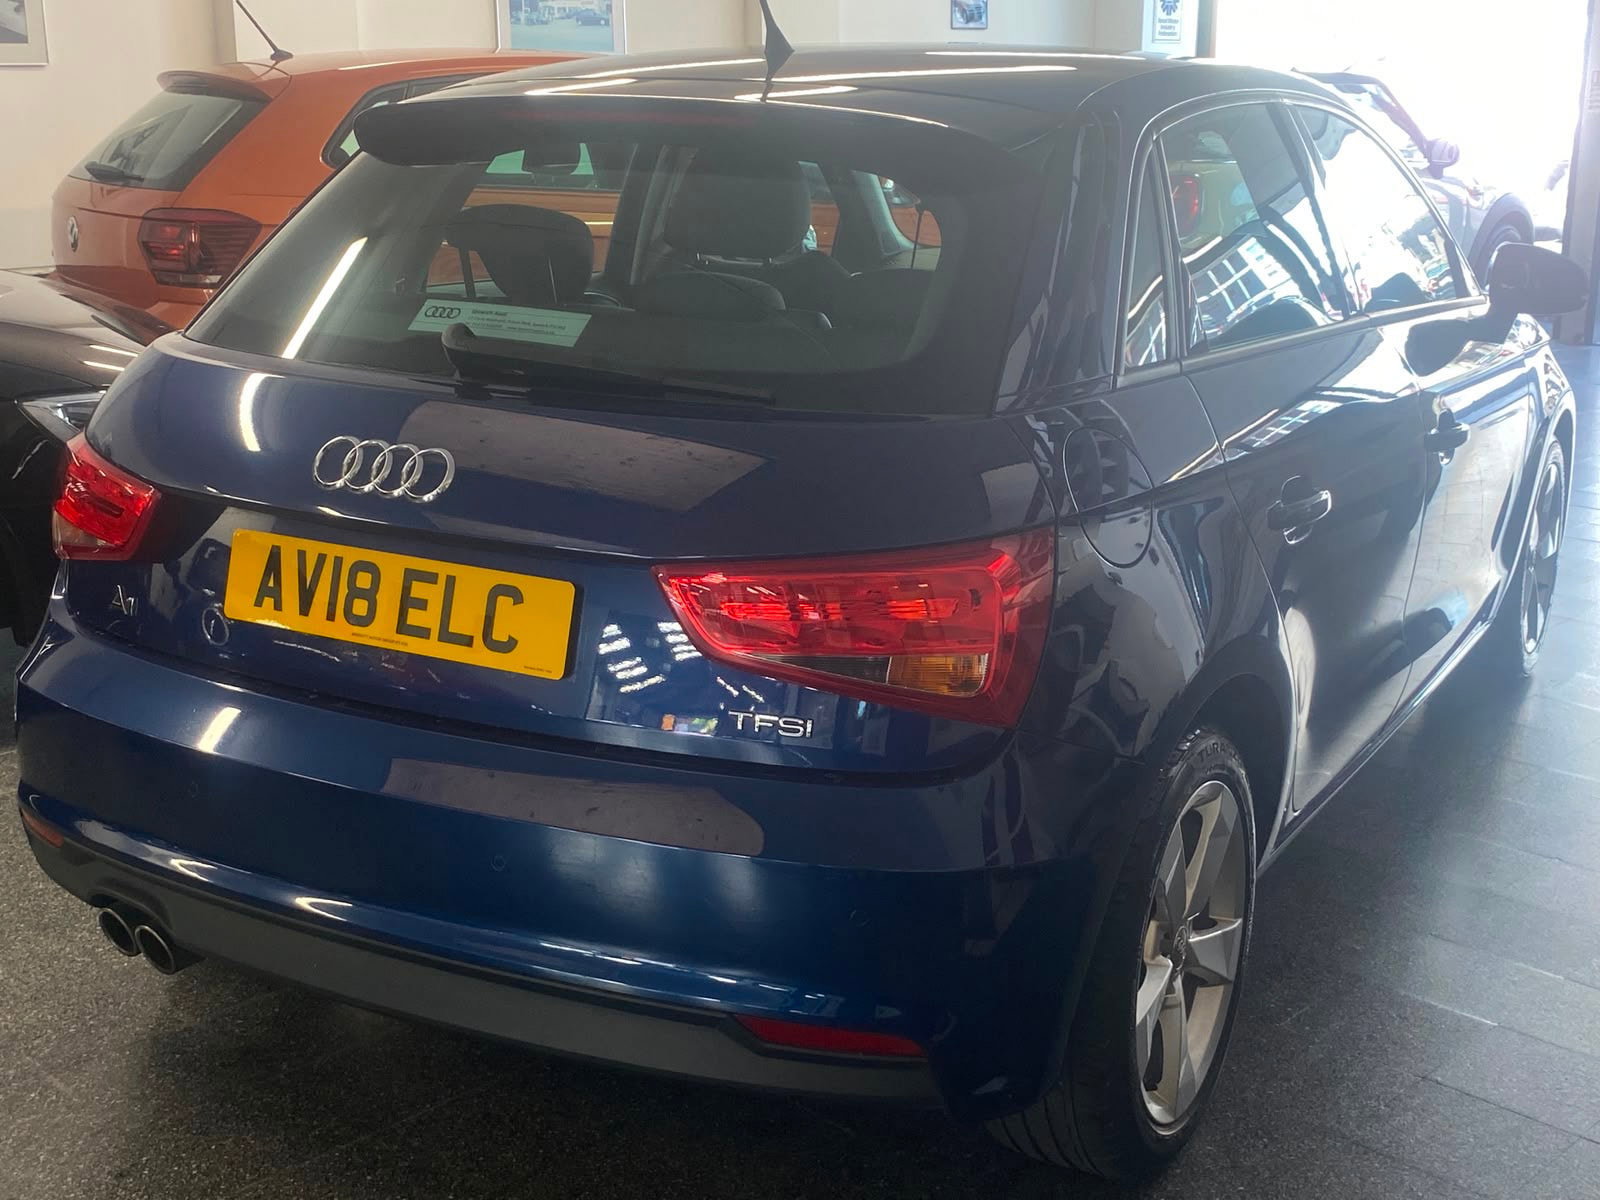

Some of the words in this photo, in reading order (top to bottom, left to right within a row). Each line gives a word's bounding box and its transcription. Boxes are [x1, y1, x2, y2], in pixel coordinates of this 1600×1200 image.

[111, 585, 137, 617] A1
[254, 545, 380, 627] AV18
[396, 568, 523, 653] ELC
[728, 709, 813, 738] TFSI
